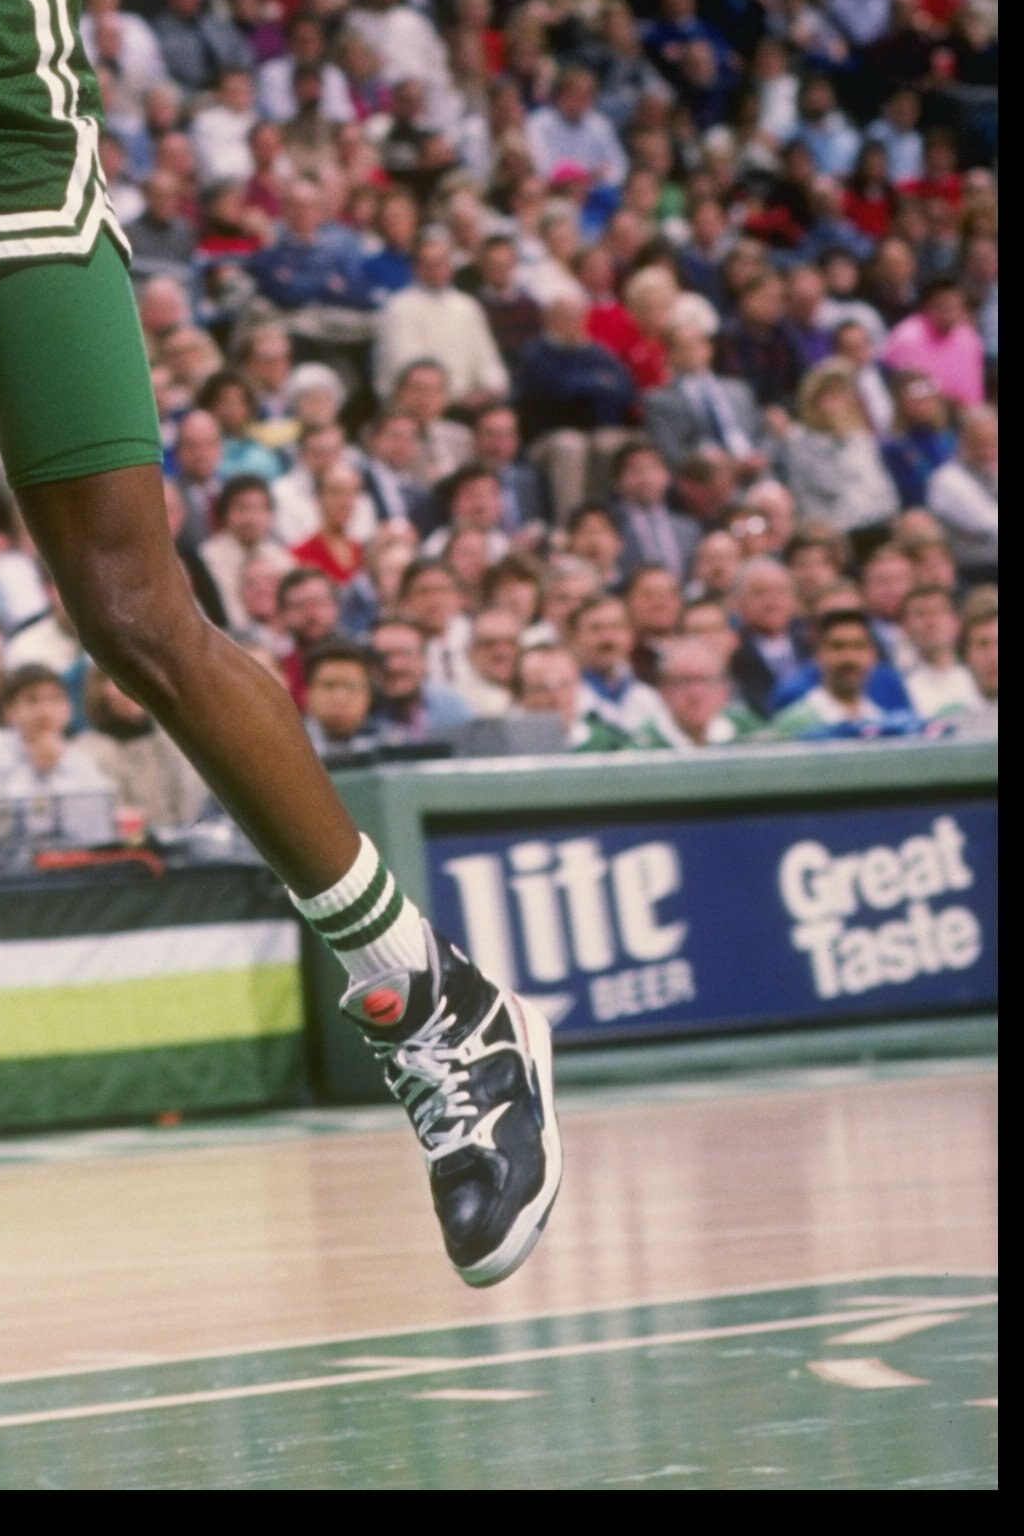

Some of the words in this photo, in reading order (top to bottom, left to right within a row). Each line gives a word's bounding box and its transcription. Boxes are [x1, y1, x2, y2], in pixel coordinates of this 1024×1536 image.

[779, 814, 974, 922] Great
[589, 959, 696, 1022] BEER
[790, 903, 981, 999] Taste
